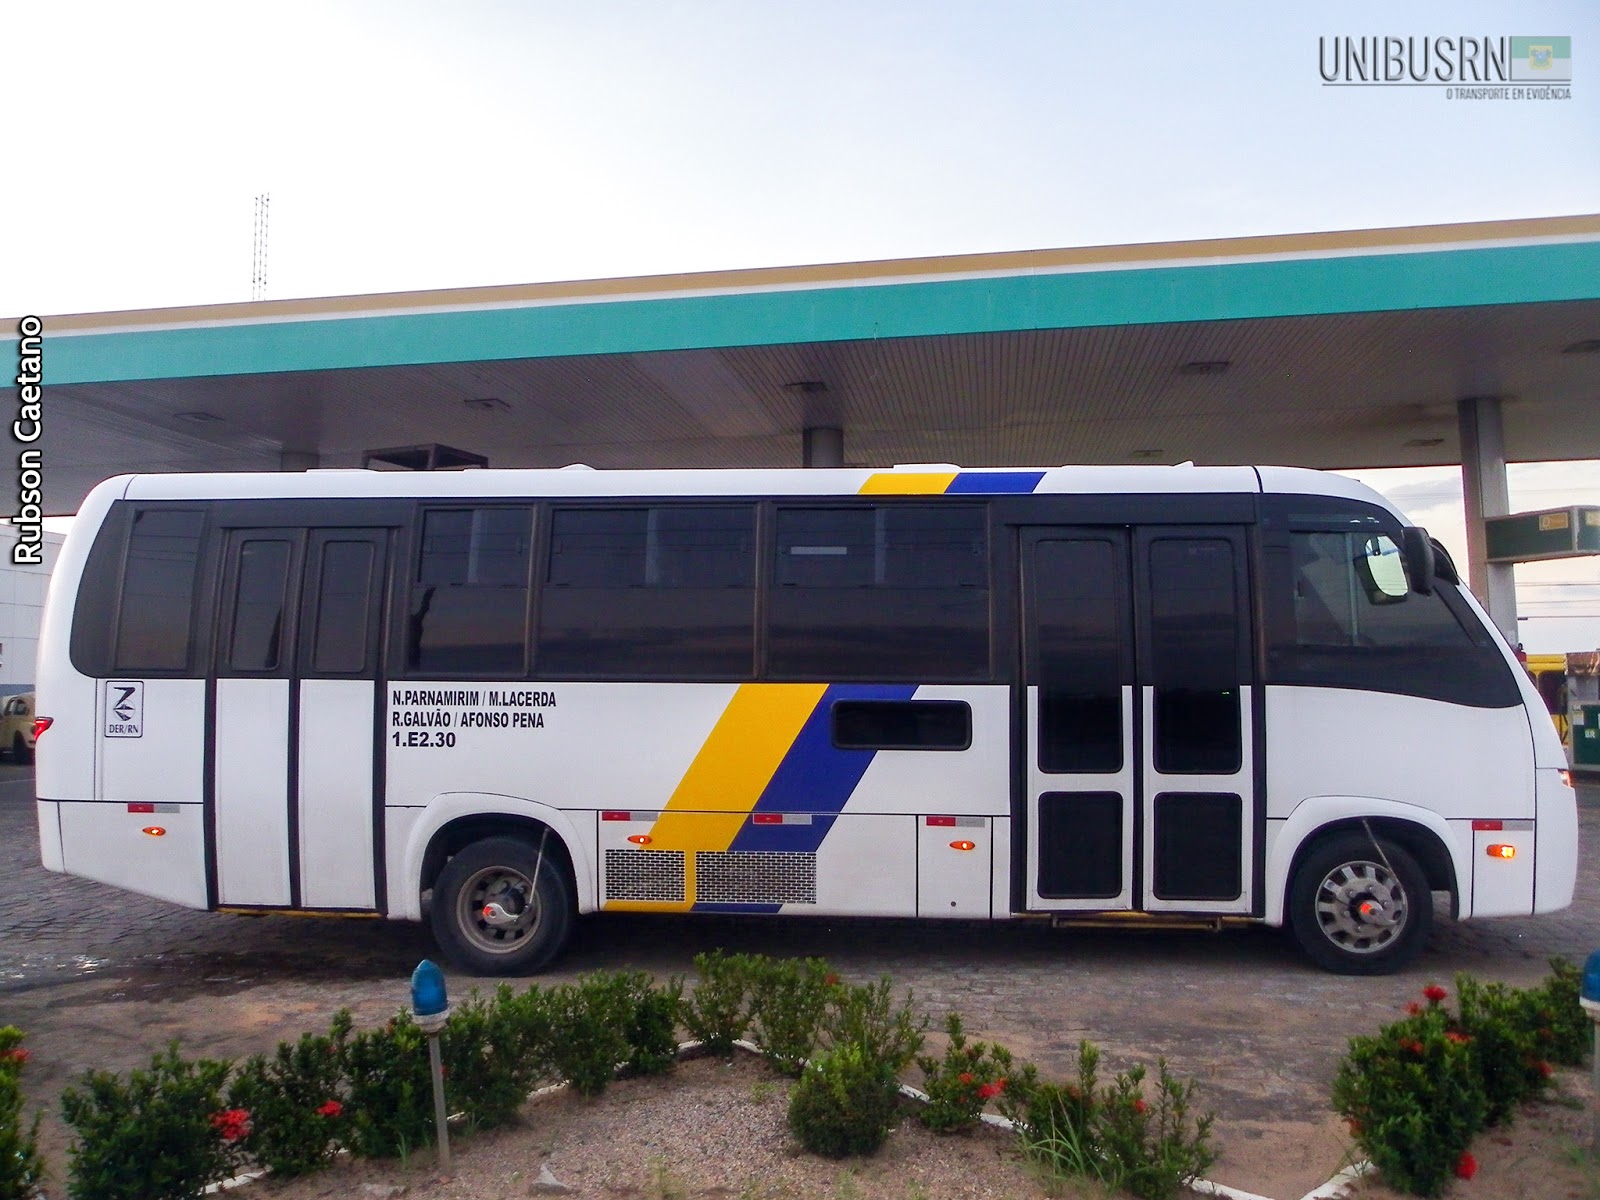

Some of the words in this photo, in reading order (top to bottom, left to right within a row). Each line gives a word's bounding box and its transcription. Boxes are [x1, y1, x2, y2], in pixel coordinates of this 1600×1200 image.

[392, 690, 479, 706] N.PARNAMIRIM
[489, 691, 556, 707] M.LACERDA
[392, 709, 451, 727] R.GALVÃO
[460, 712, 509, 728] AFONSO
[512, 713, 545, 728] PENA
[109, 724, 139, 734] DER/RN
[392, 731, 456, 747] 1.E2.30
